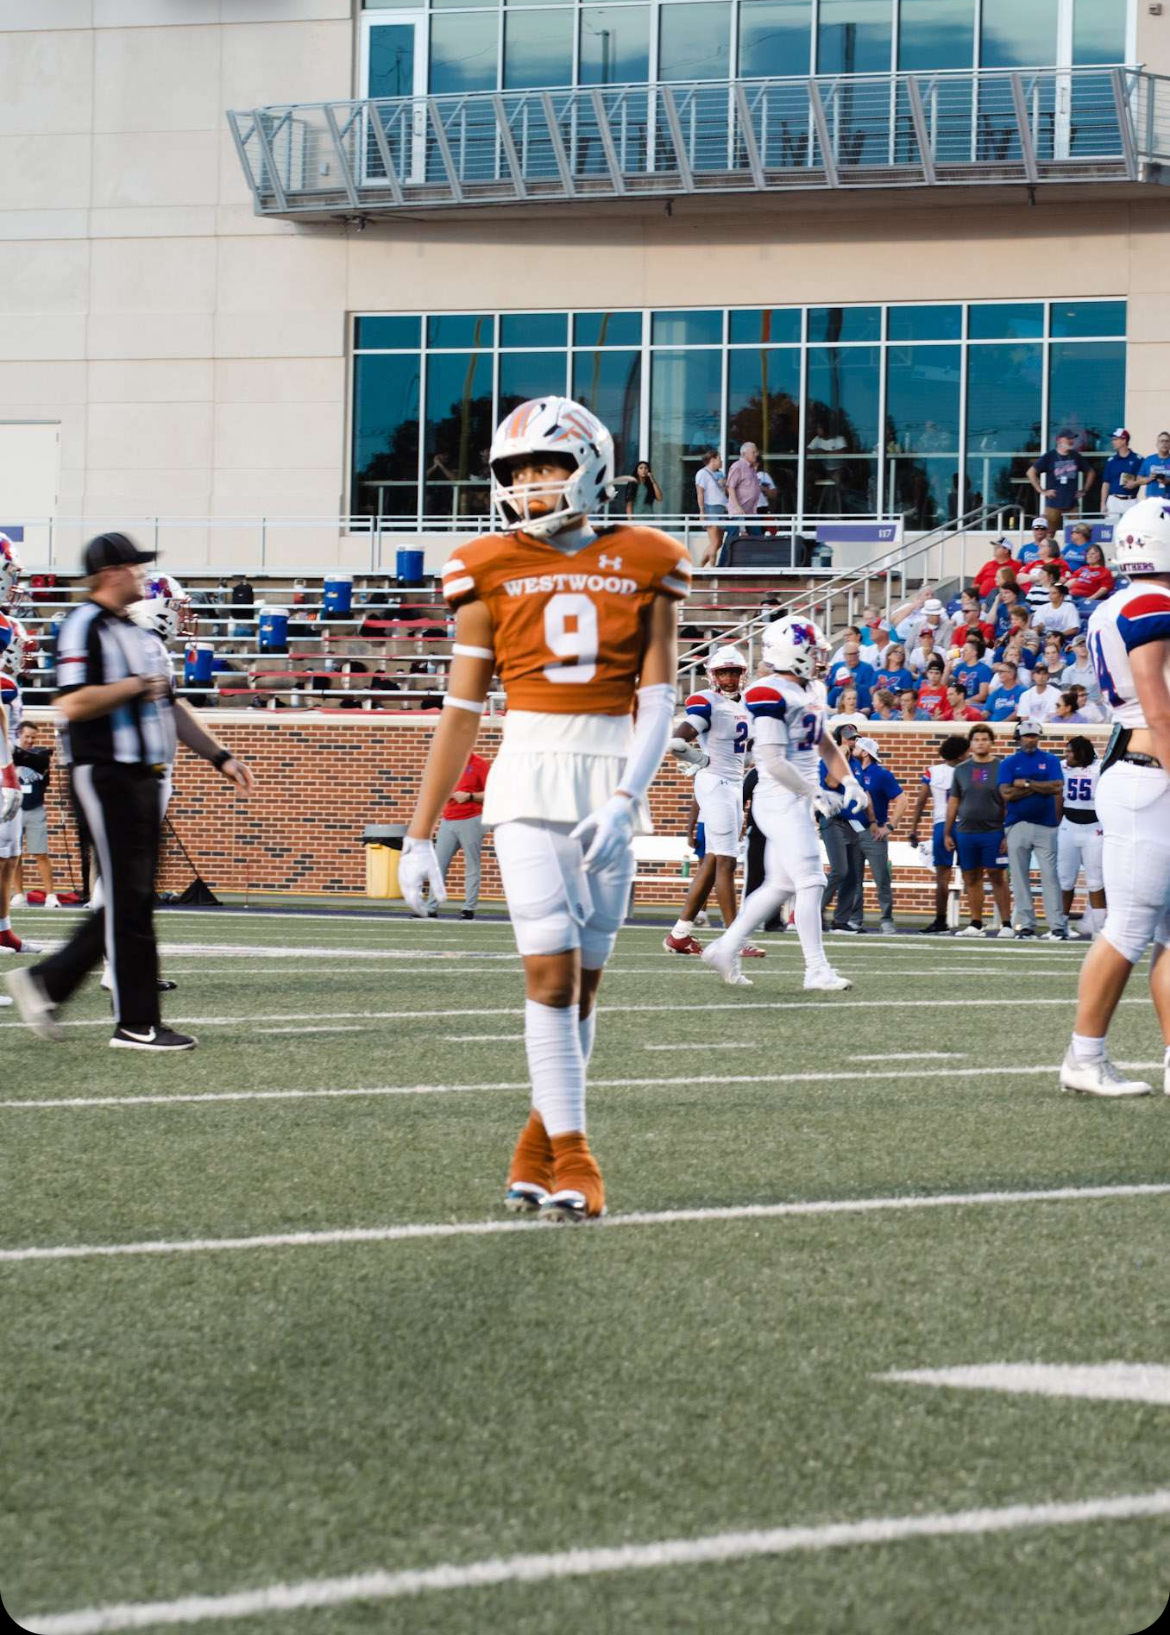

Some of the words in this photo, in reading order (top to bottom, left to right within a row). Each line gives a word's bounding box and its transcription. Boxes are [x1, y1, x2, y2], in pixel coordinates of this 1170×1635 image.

[878, 529, 892, 538] 117
[502, 573, 638, 597] WESTWOOD
[541, 592, 599, 684] 9
[1067, 778, 1092, 801] 55
